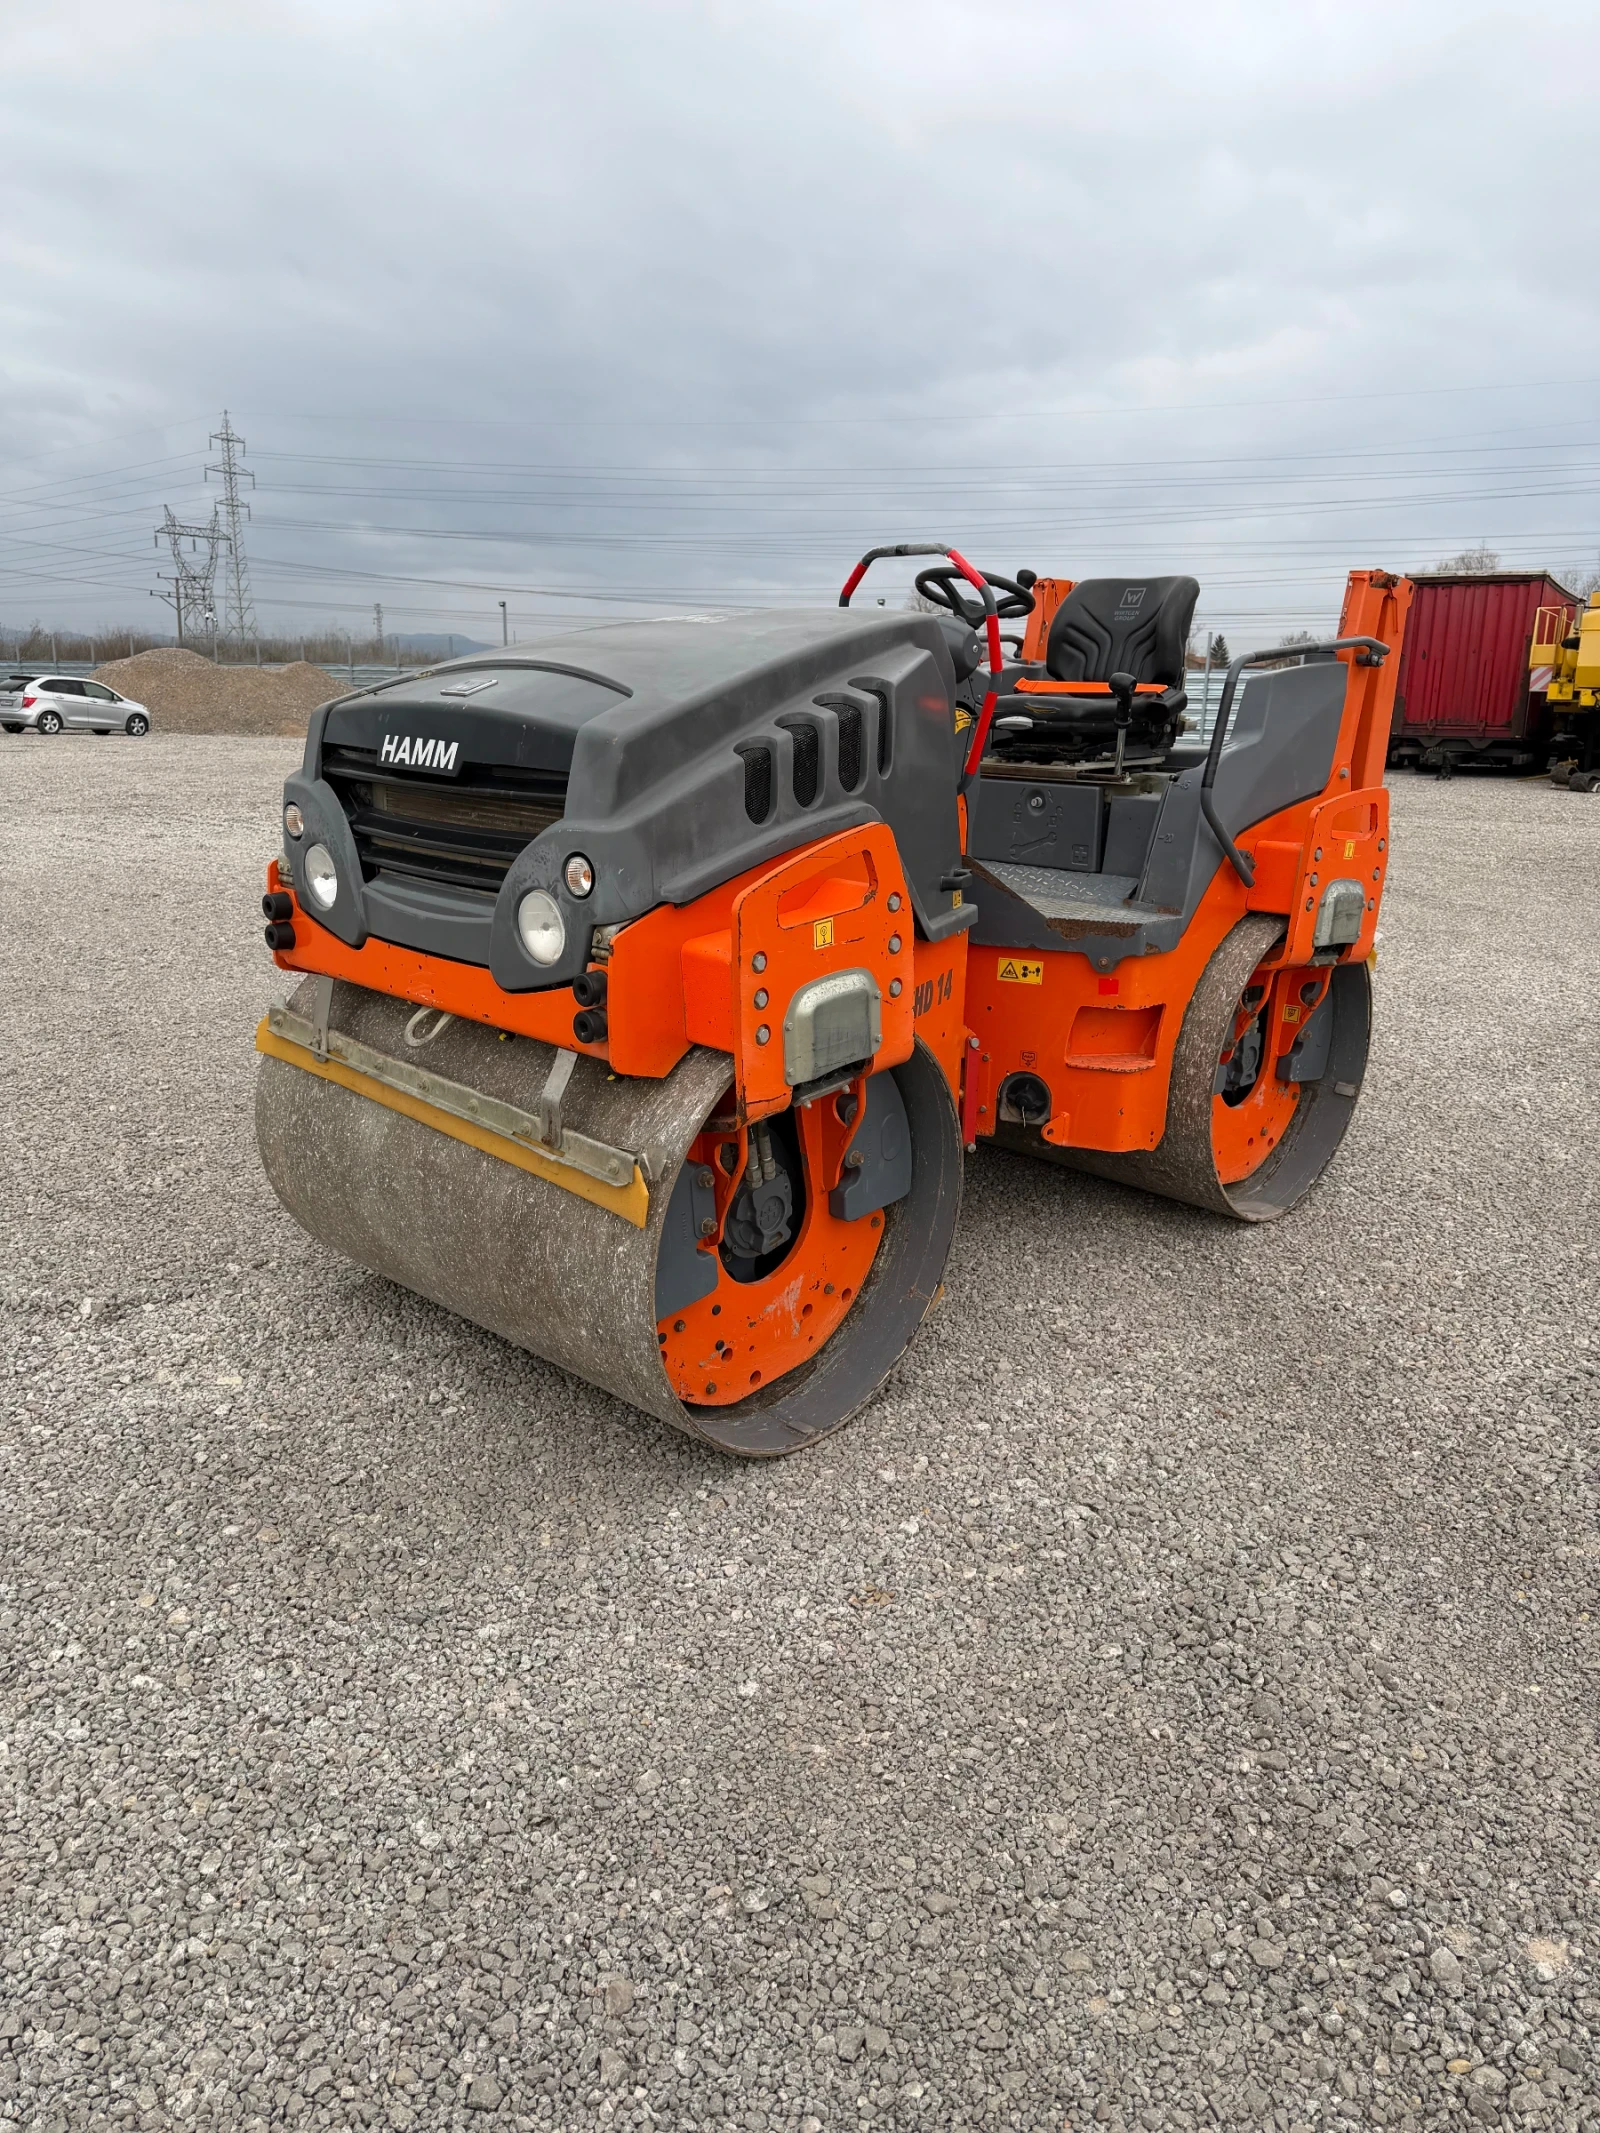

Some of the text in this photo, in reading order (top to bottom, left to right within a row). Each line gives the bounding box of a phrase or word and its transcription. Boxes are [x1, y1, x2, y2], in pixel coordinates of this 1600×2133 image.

[380, 734, 460, 770] HAMM
[913, 968, 953, 1019] HD 14
